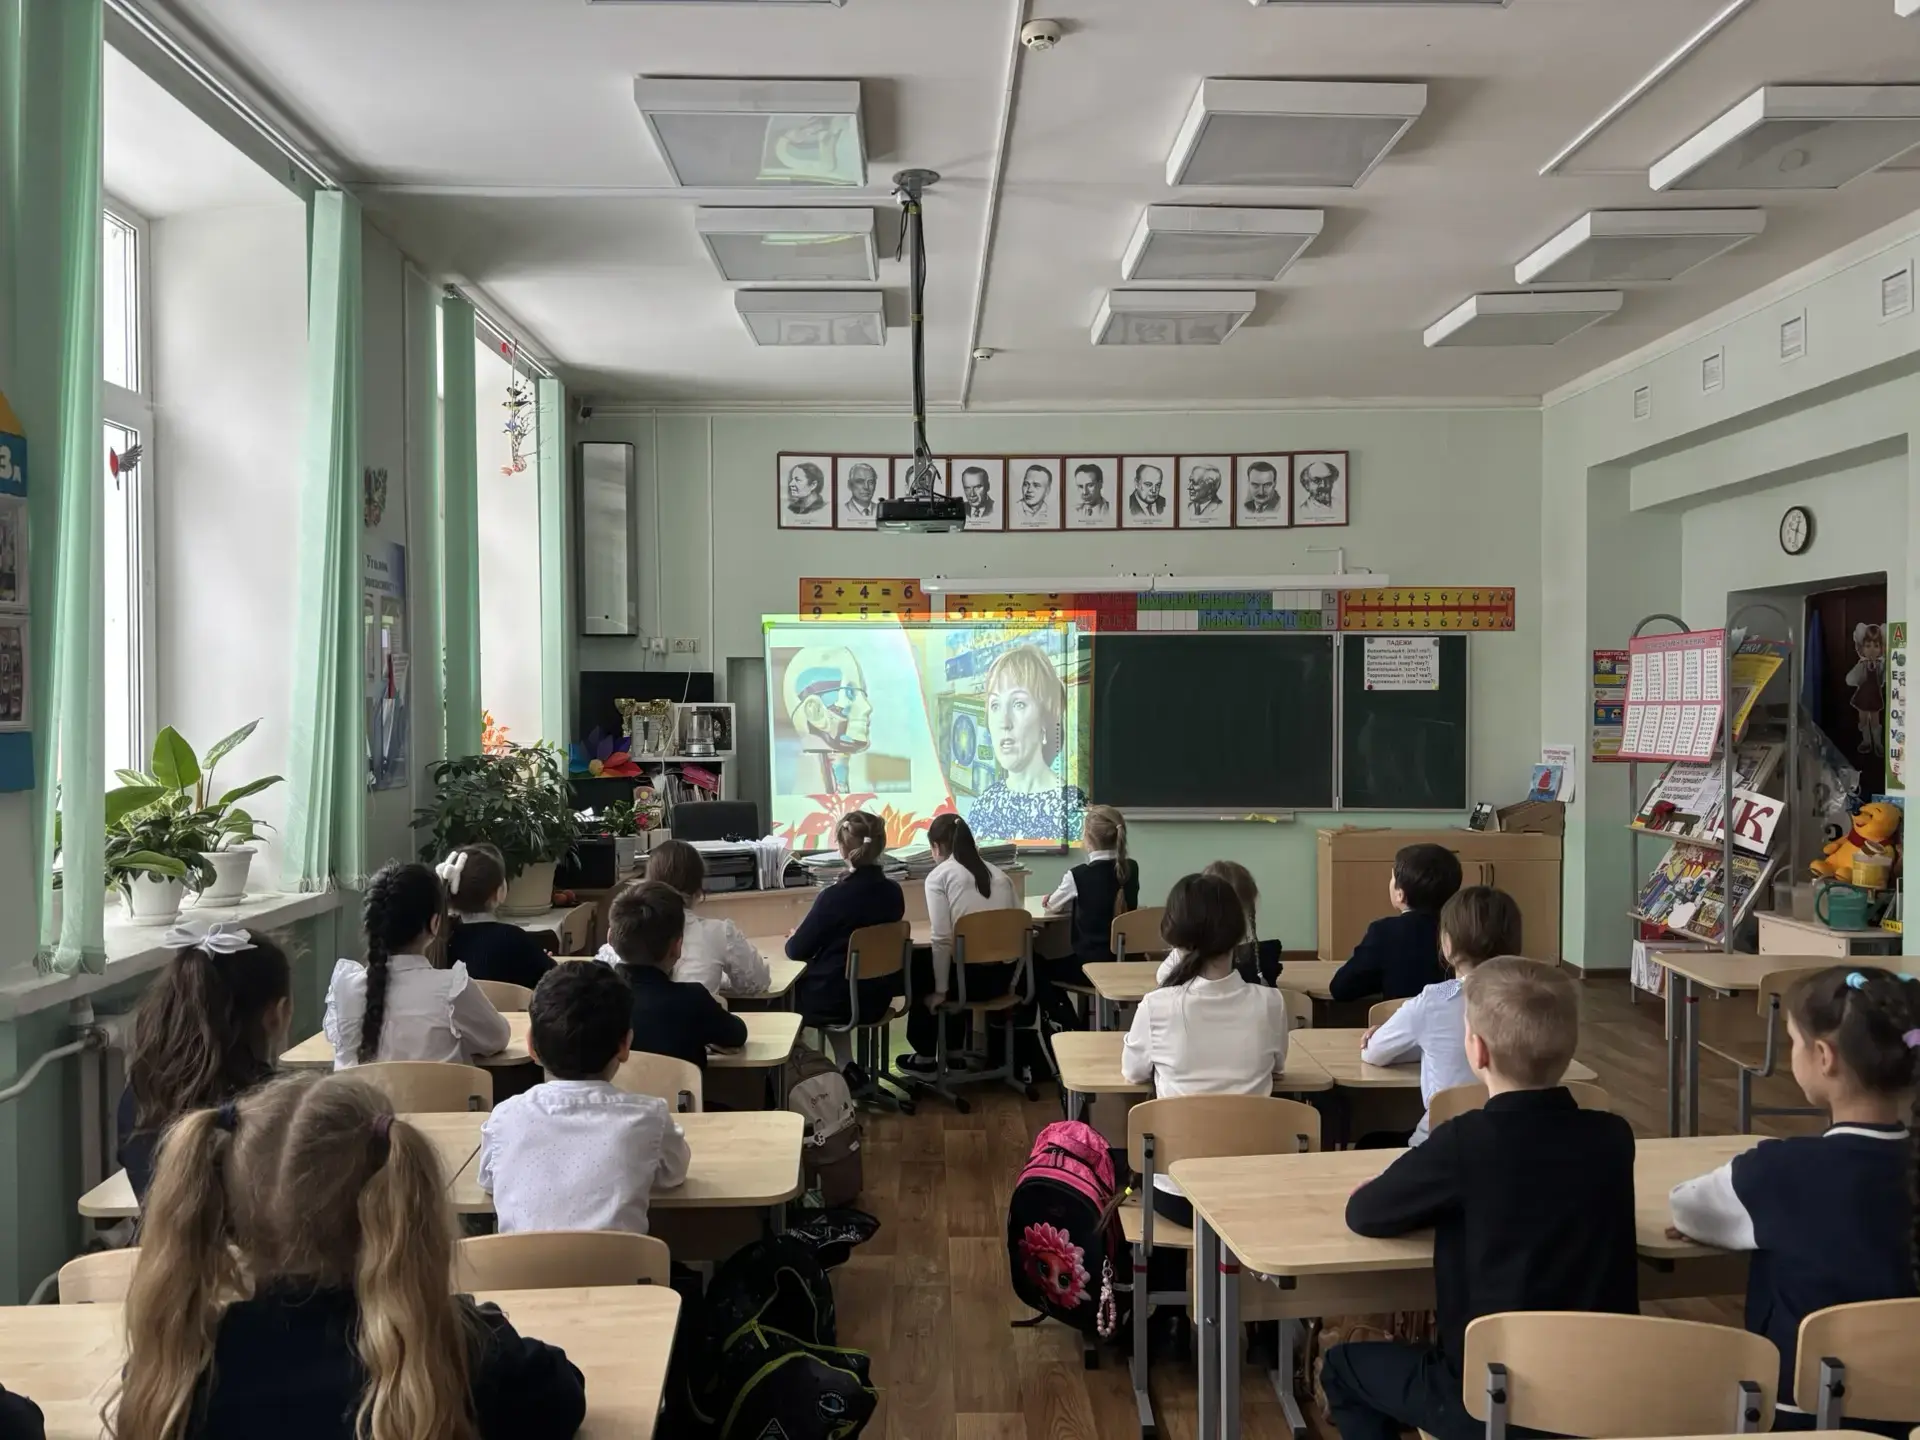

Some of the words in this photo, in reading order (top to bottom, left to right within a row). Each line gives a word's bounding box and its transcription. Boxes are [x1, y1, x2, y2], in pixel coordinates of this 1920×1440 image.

[814, 585, 823, 599] 2
[860, 585, 869, 599] 4
[904, 585, 913, 599] 6
[1344, 592, 1350, 601] 0
[1361, 592, 1367, 601] 1
[1377, 592, 1384, 601] 2
[1393, 592, 1399, 601] 3
[1408, 592, 1415, 601] 4
[1424, 592, 1430, 601] 5
[1441, 592, 1448, 601] 6
[1457, 592, 1462, 601] 7
[1472, 592, 1479, 601] 8
[1489, 592, 1494, 601] 9
[1501, 592, 1512, 601] 10
[1325, 593, 1336, 604] Ъ
[813, 607, 822, 619] 9
[860, 606, 868, 620] 5
[903, 607, 913, 620] 4
[1004, 607, 1013, 620] 3
[1225, 615, 1233, 626] К
[1327, 615, 1335, 626] Ь
[1344, 618, 1350, 627] 0
[1361, 618, 1367, 627] 1
[1377, 618, 1384, 627] 2
[1393, 618, 1399, 627] 3
[1408, 618, 1415, 627] 4
[1424, 618, 1430, 627] 5
[1441, 618, 1448, 627] 6
[1457, 618, 1462, 627] 7
[1472, 618, 1479, 627] 8
[1489, 618, 1494, 627] 9
[1501, 618, 1512, 627] 10
[1894, 625, 1903, 641] А
[1891, 651, 1898, 661] А
[1892, 671, 1898, 680] Е
[1891, 687, 1899, 700] Й
[1891, 729, 1898, 739] У
[1734, 799, 1774, 844] К
